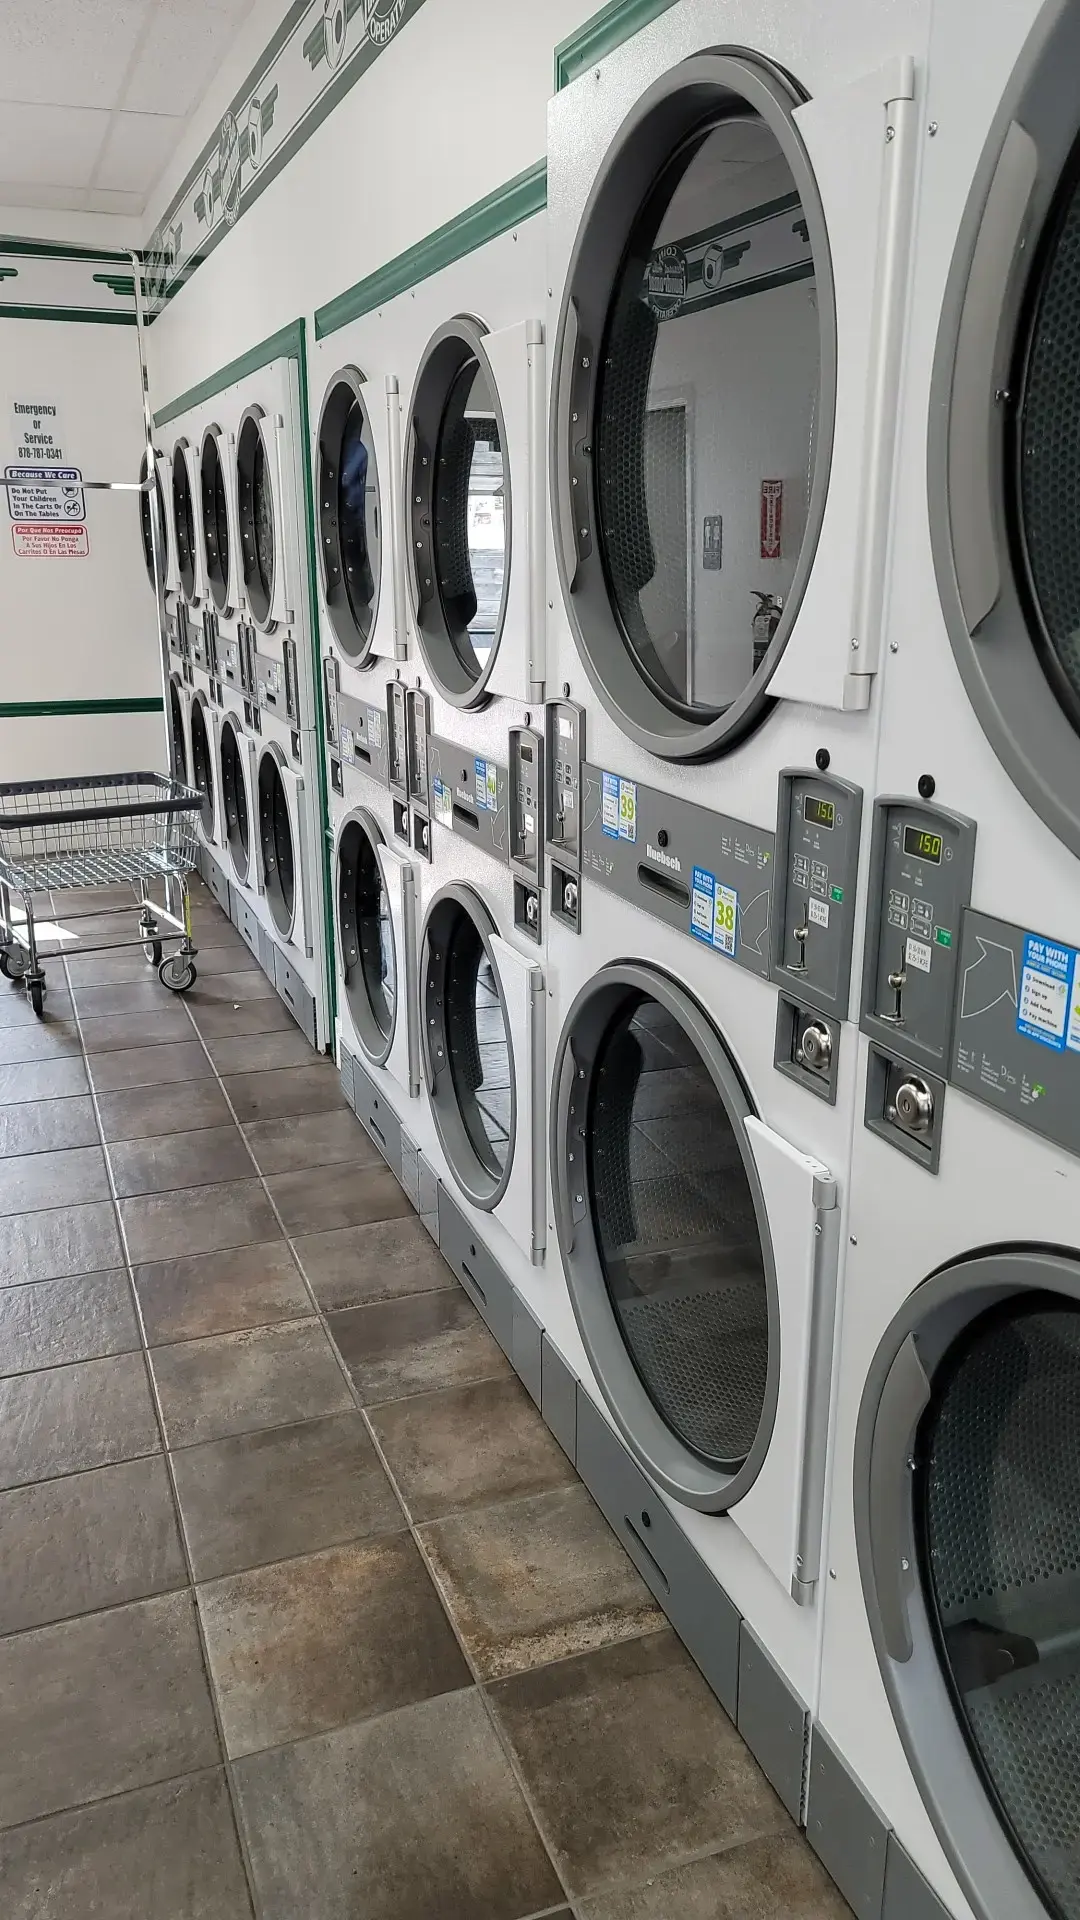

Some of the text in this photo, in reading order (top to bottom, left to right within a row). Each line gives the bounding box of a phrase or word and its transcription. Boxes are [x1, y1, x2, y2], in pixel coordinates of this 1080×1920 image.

[14, 402, 56, 416] Emergency
[33, 420, 41, 429] or
[24, 432, 53, 444] Service
[621, 795, 634, 820] 39
[919, 833, 941, 855] 150
[646, 843, 681, 872] Huebsch
[715, 900, 734, 930] 38
[1028, 940, 1069, 963] PAY WITH
[1027, 950, 1045, 963] YOUR
[1045, 957, 1068, 972] PHONE
[1032, 976, 1055, 991] Download
[1031, 988, 1041, 997] Sign
[1030, 1000, 1053, 1015] Add funds
[1038, 1016, 1057, 1029] machine
